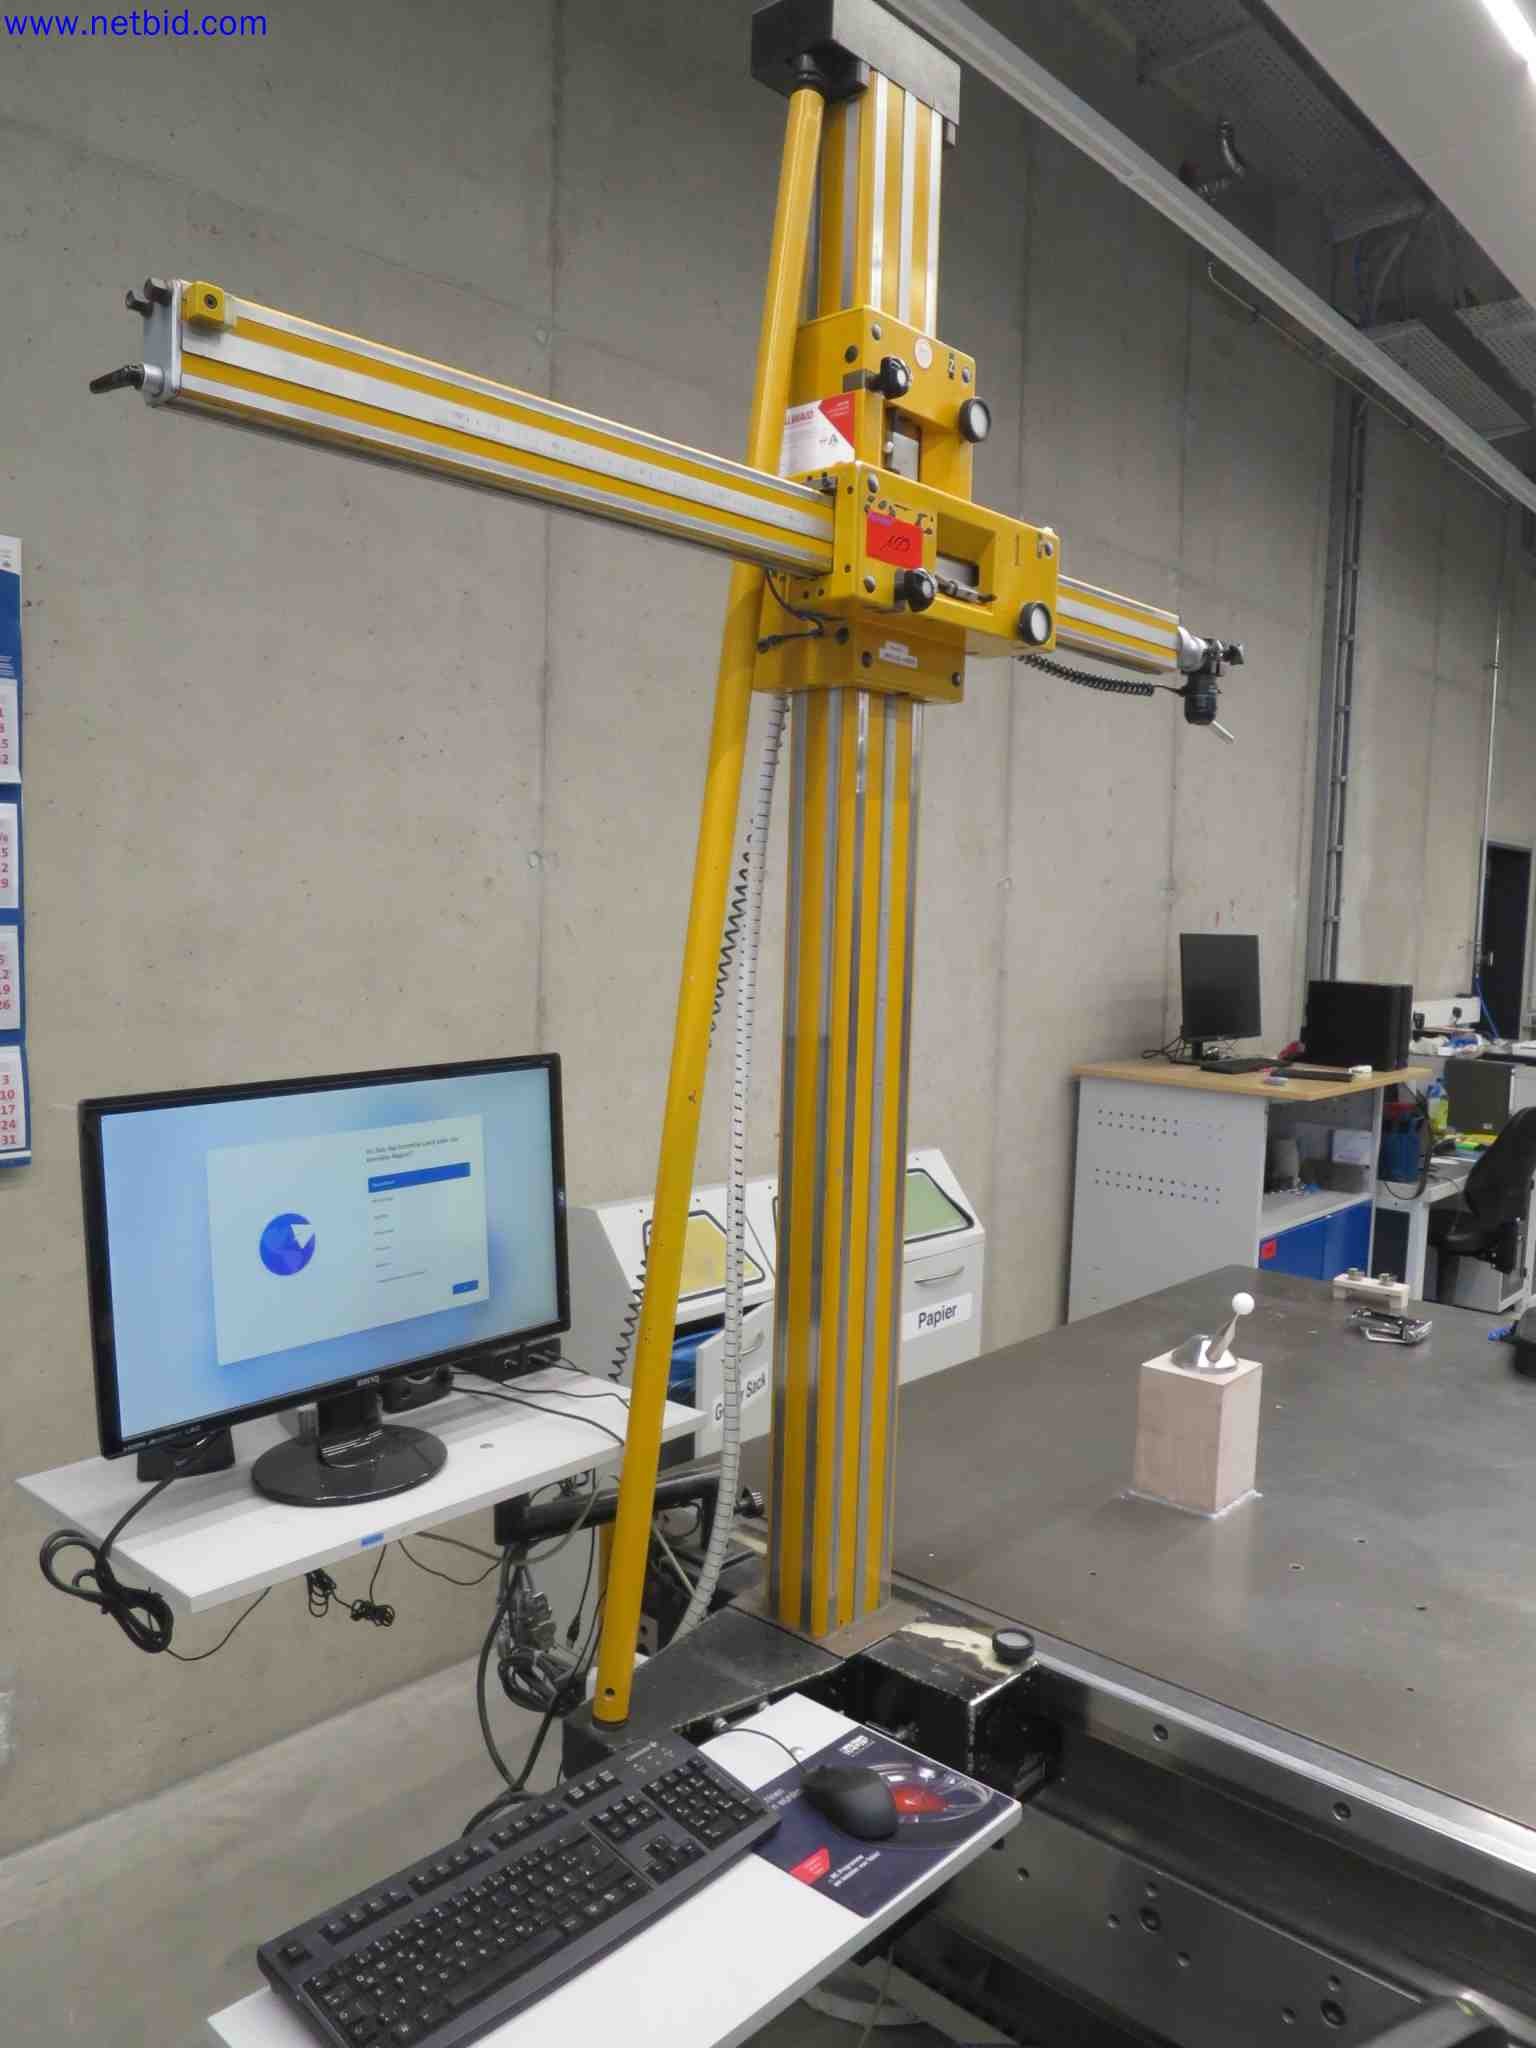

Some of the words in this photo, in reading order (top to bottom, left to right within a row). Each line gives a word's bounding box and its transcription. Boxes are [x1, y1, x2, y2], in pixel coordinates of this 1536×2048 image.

[3, 1074, 10, 1085] 3
[0, 1089, 16, 1101] 10
[1, 1104, 16, 1116] 17
[0, 1119, 16, 1131] 24
[0, 1134, 17, 1146] 31
[918, 1304, 958, 1330] Papier
